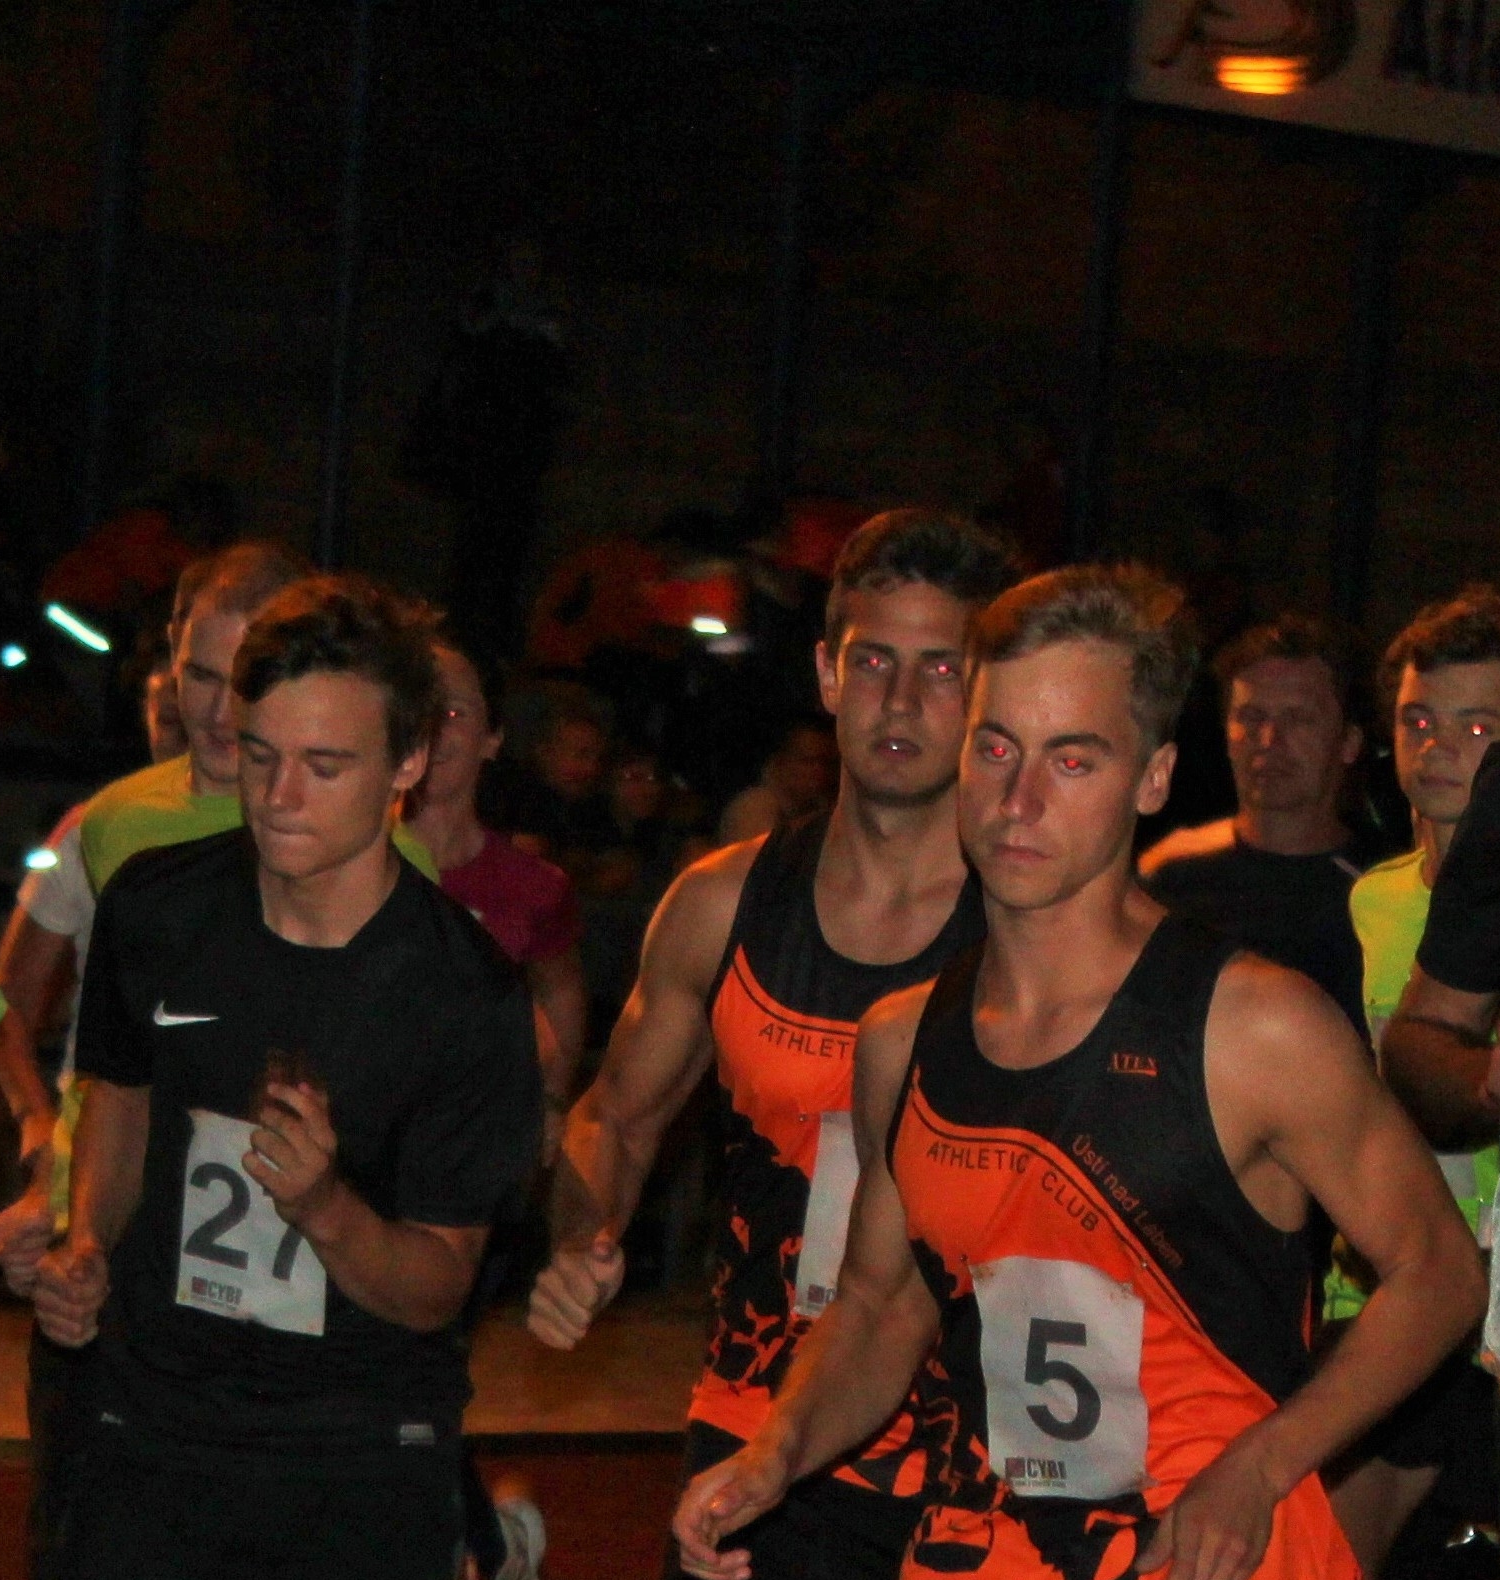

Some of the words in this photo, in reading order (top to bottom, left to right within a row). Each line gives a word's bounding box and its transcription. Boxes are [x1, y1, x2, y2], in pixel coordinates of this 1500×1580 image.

[926, 1140, 1030, 1174] ATHLETIC
[1041, 1171, 1099, 1231] CLUB
[1024, 1316, 1101, 1442] 5
